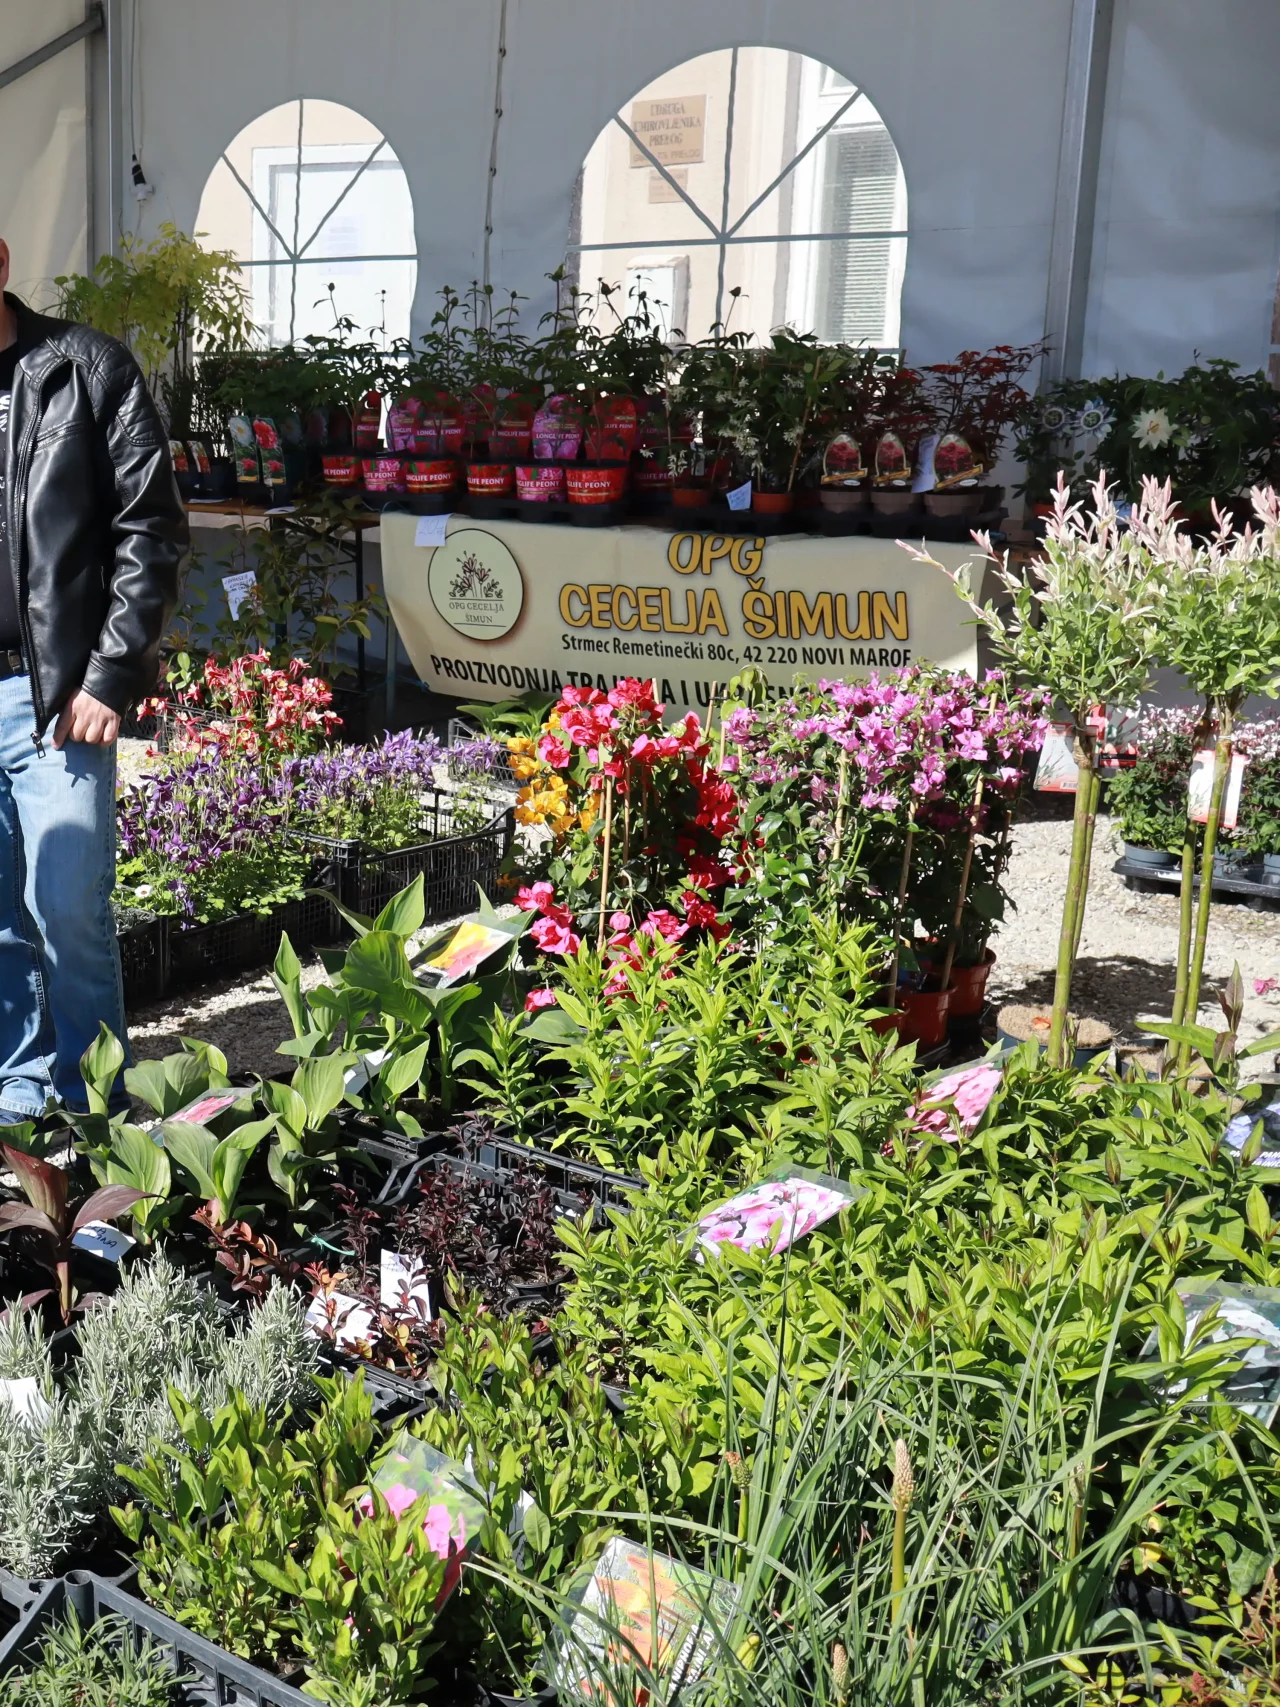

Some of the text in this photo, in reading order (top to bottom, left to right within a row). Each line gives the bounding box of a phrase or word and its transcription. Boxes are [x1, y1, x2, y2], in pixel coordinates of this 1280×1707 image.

[330, 468, 351, 476] PEONY
[374, 471, 397, 479] PEONY
[429, 474, 451, 482] PEONY
[481, 477, 505, 485] PEONY
[535, 480, 560, 488] PEONY
[584, 480, 611, 488] PEONY
[667, 531, 766, 576] OPG
[448, 601, 505, 614] OPG CECELJA
[558, 576, 910, 641] CECELJA ŠIMUN
[465, 613, 494, 624] ŠIMUN
[561, 633, 912, 668] Strmec Remetinečki 80c, 42 220 NOVI MAROF
[429, 654, 564, 694] PROIZVODNJA
[680, 679, 690, 706] I
